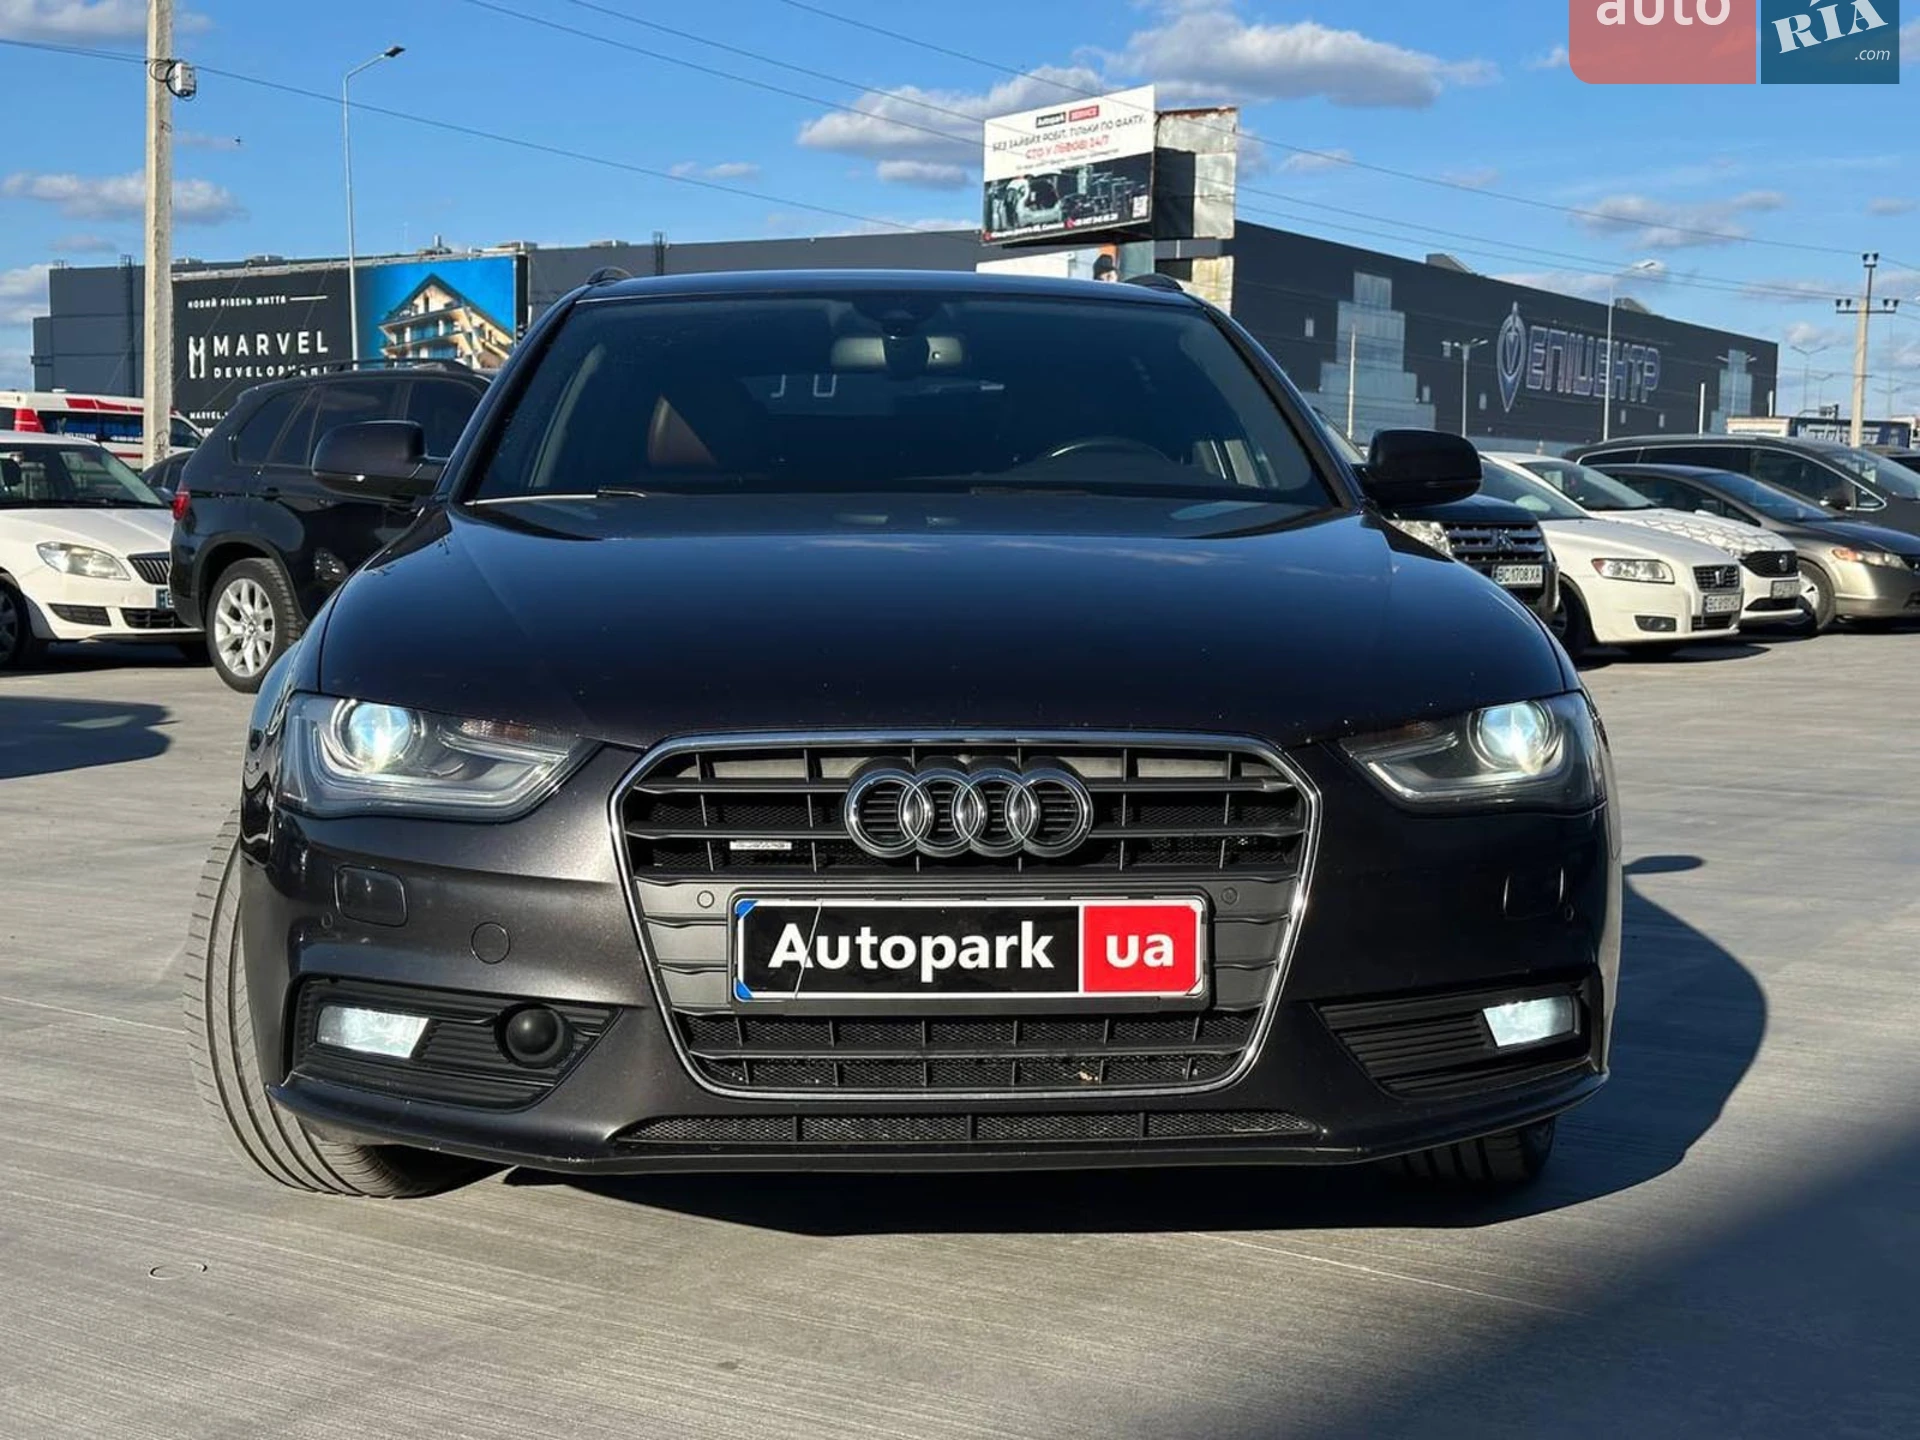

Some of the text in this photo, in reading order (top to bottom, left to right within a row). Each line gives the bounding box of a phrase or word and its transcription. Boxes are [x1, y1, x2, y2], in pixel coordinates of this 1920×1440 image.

[1101, 120, 1114, 131] ПО
[1025, 148, 1045, 160] СТО
[187, 295, 286, 309] НОВИЙ РІВЕНЬ ЖИТТЯ
[213, 331, 328, 357] MARVEL
[768, 920, 1174, 983] Autopark ua
